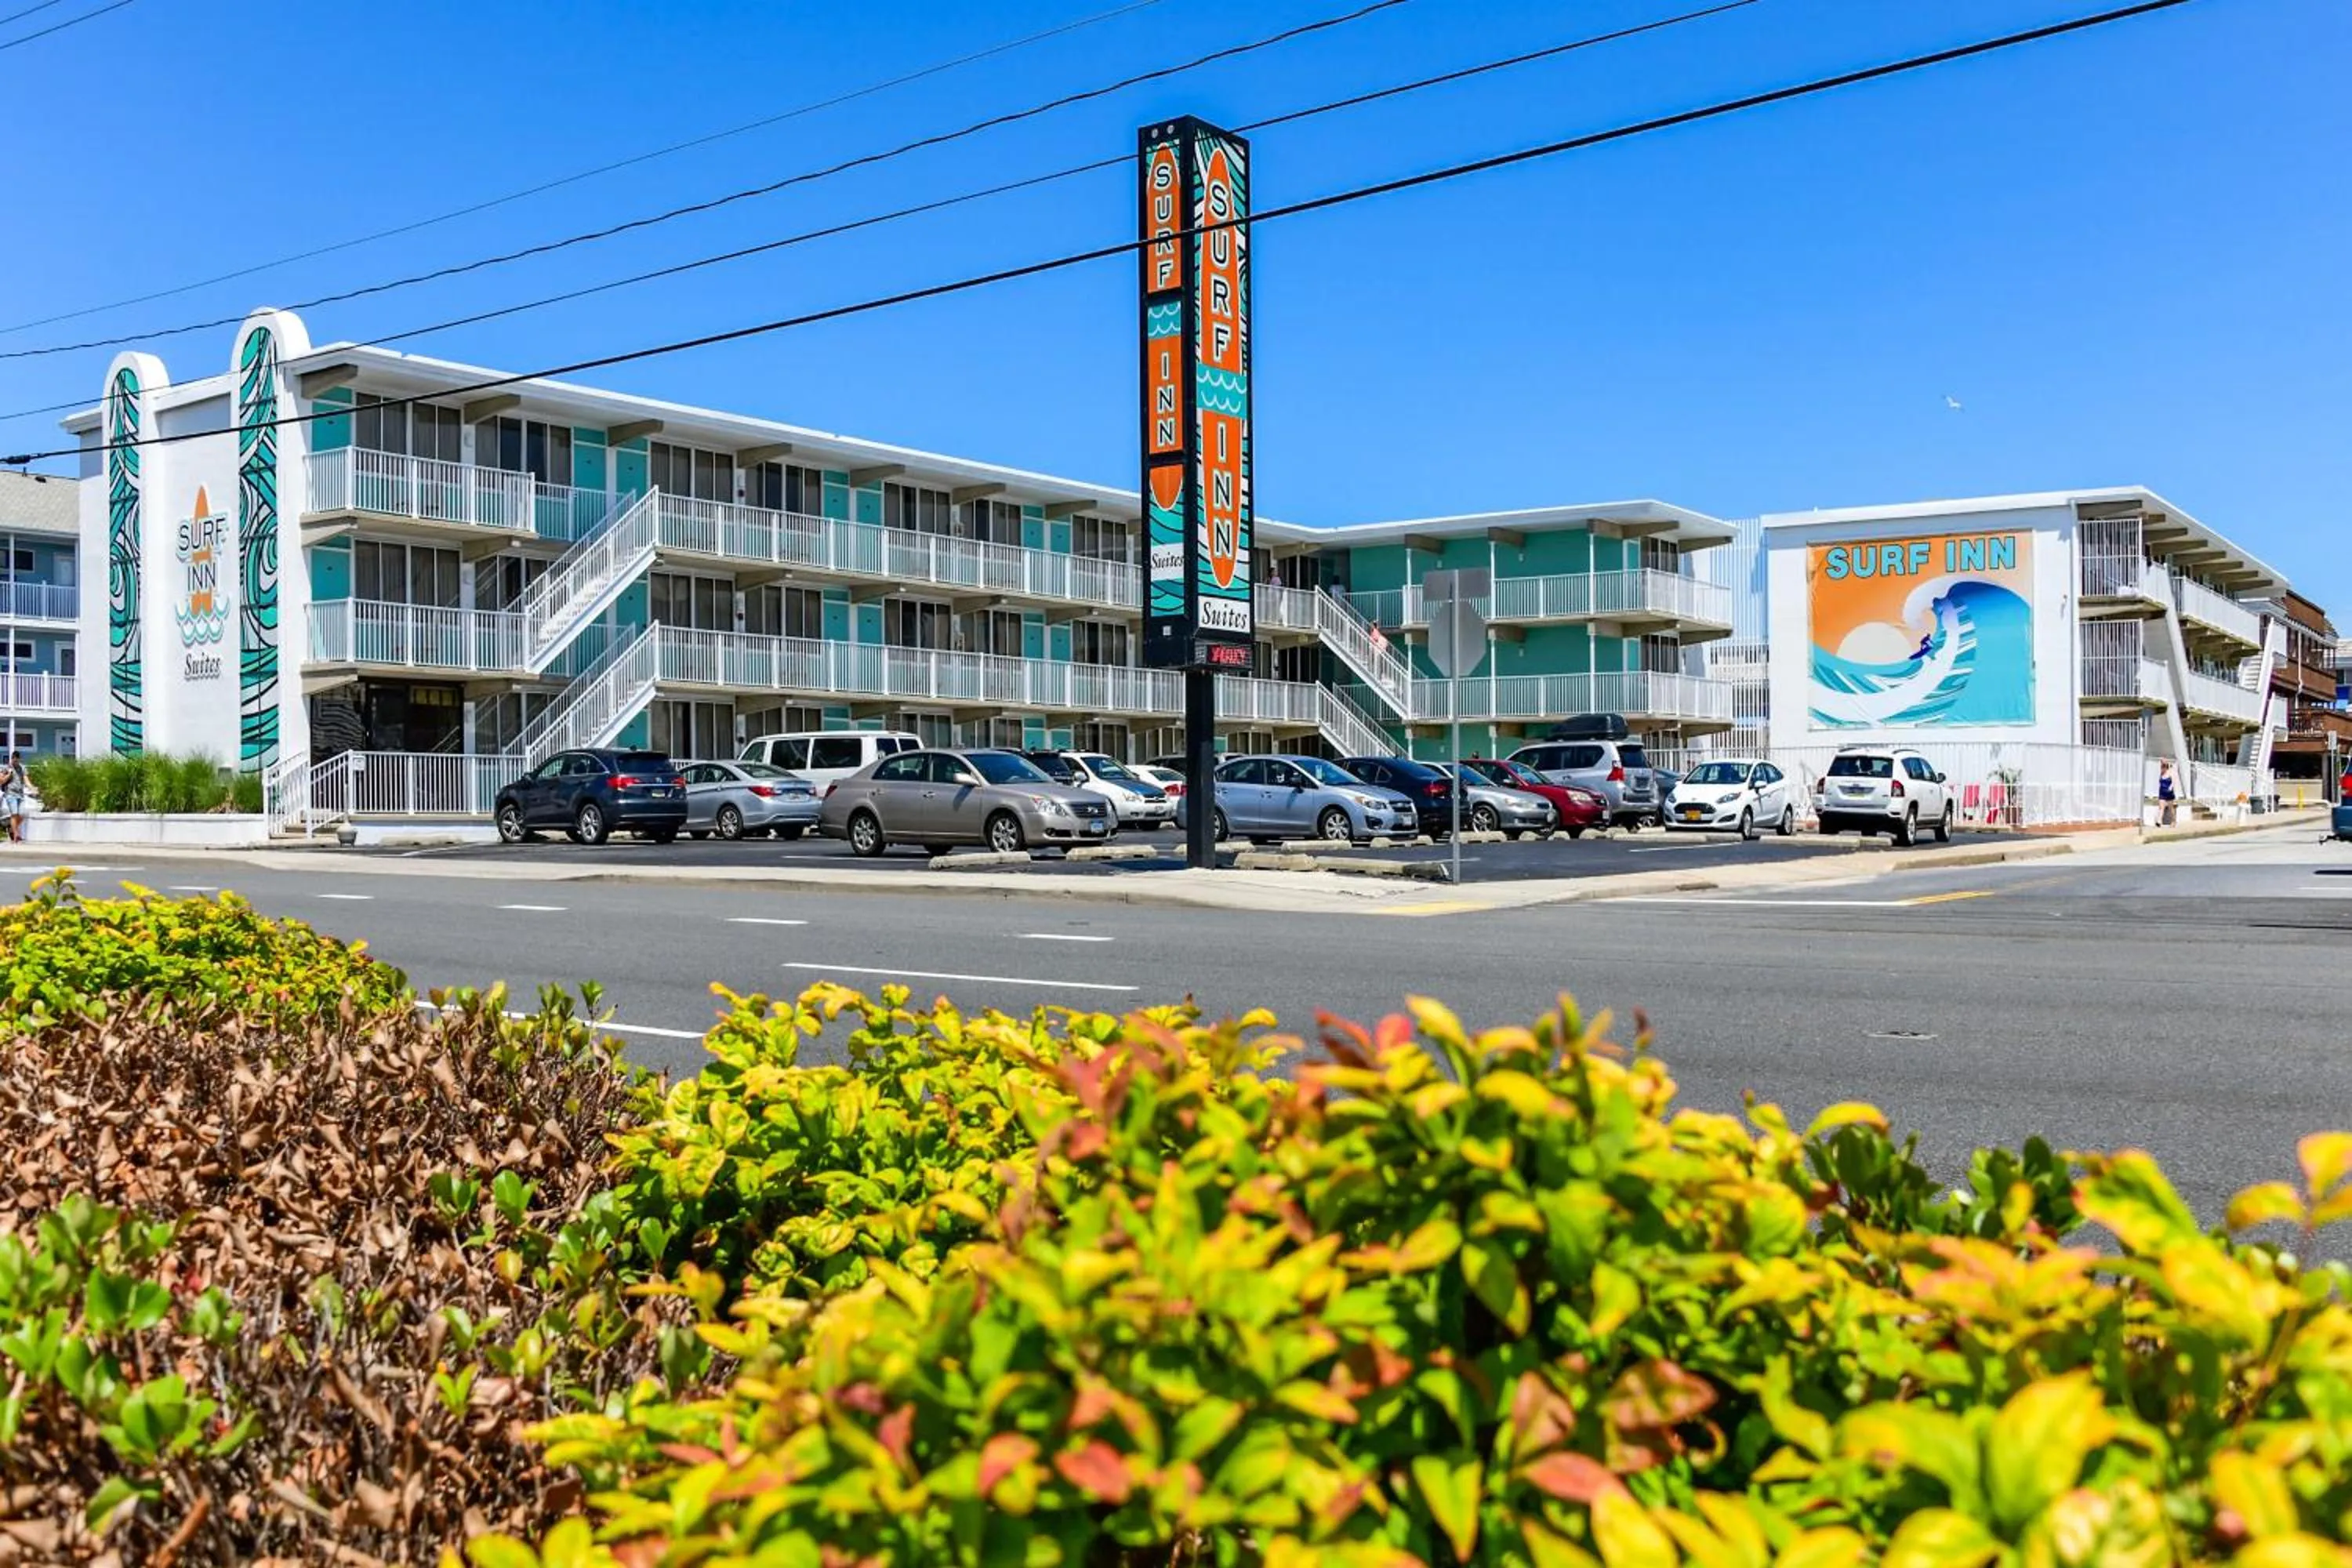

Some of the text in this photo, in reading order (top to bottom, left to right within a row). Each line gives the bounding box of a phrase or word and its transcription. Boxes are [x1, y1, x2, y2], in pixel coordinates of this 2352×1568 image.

[1155, 164, 1174, 447] SURF INN
[1211, 181, 1232, 558] SURF INN
[179, 517, 225, 551] SURF
[1152, 551, 1184, 569] Suites
[1825, 535, 2016, 580] SURF INN
[187, 561, 216, 592] INN
[1202, 601, 1247, 630] Suites
[184, 652, 221, 677] Suites
